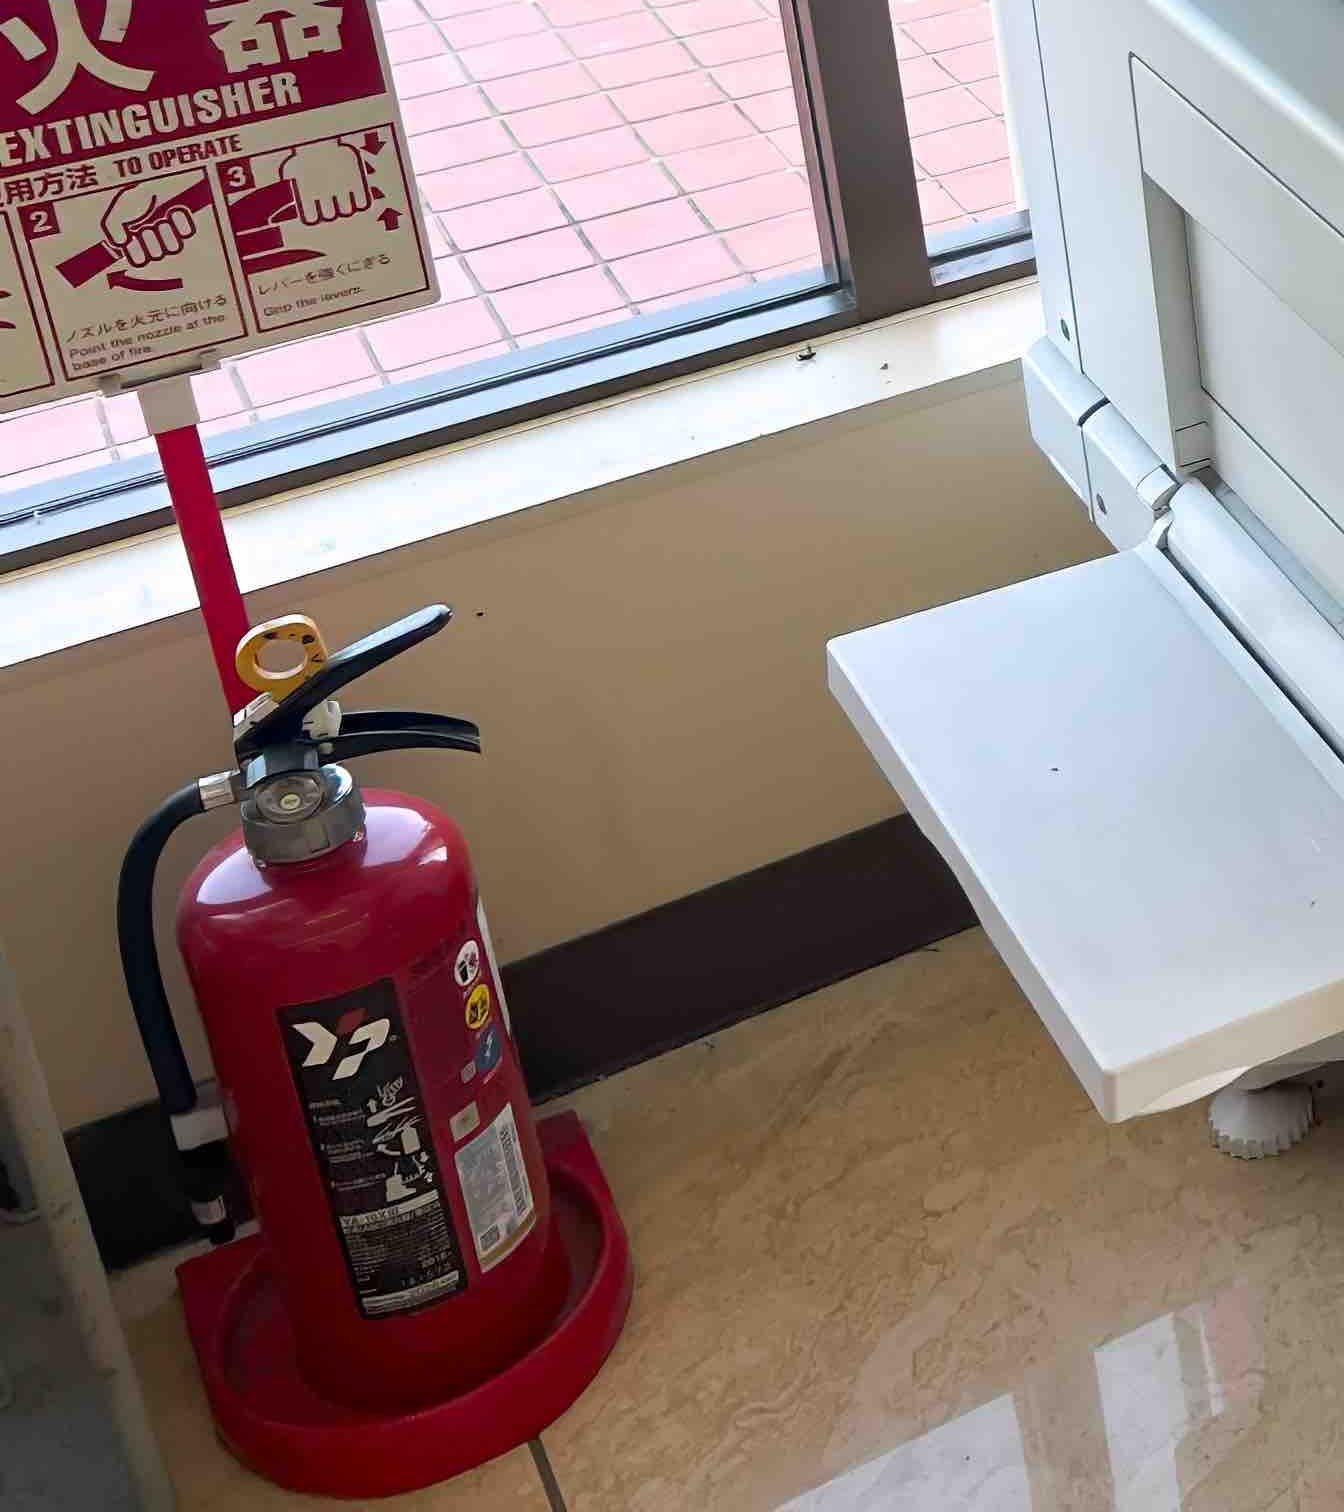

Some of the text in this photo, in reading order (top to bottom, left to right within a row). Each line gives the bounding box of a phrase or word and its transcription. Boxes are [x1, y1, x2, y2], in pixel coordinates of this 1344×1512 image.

[0, 71, 302, 168] EXTINGUISHER
[113, 134, 244, 178] TO OPERATE
[227, 167, 248, 188] 3
[0, 163, 99, 206] 用方法
[30, 208, 53, 232] 2
